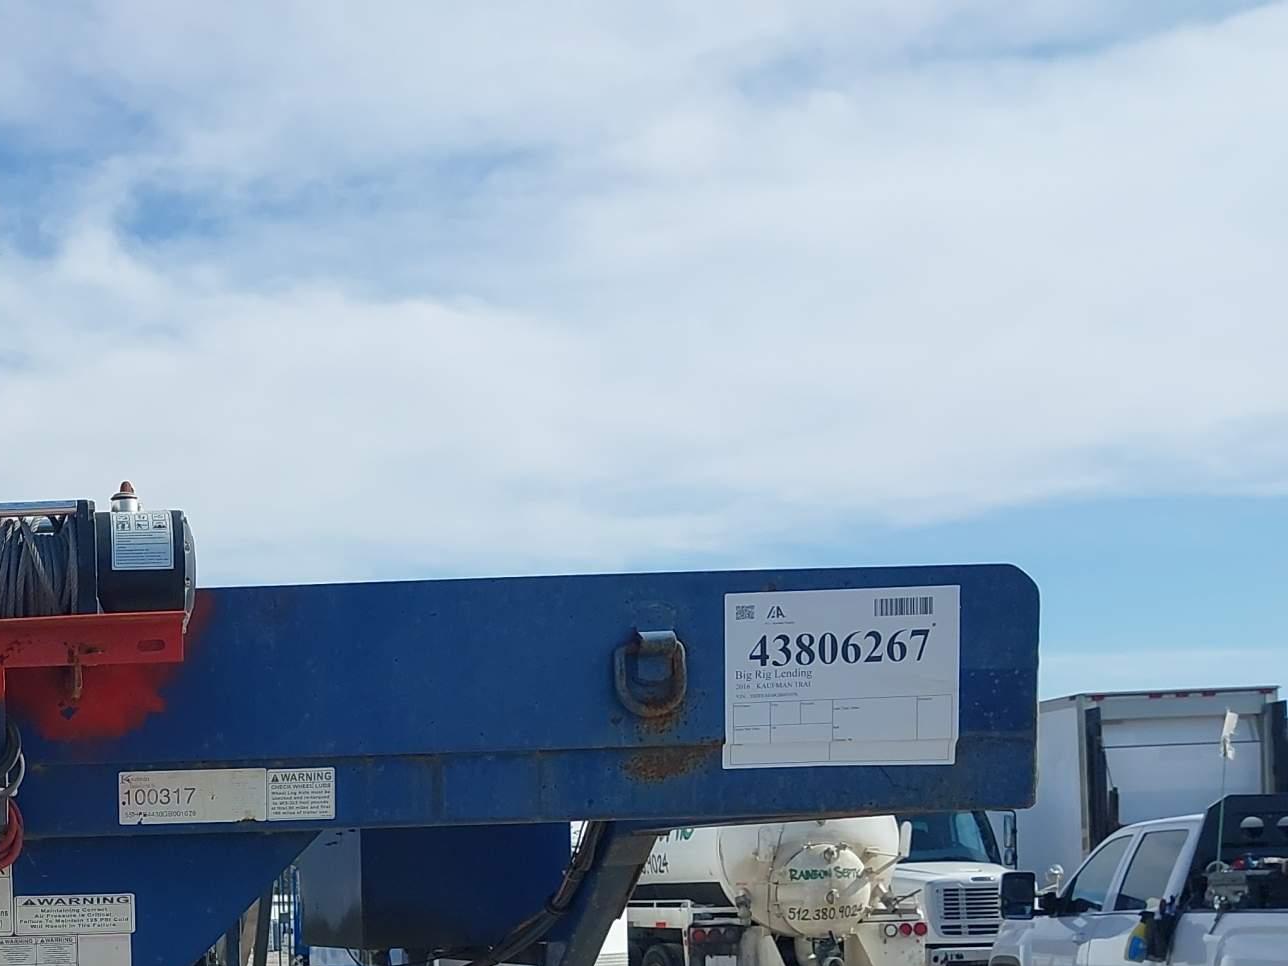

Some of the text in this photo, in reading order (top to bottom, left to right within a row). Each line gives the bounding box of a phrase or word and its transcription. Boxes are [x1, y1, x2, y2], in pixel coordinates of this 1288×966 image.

[749, 629, 930, 666] 43806267
[735, 668, 813, 681] Big Rig Lending
[281, 772, 332, 782] WARNING
[124, 787, 196, 805] 100317
[37, 896, 129, 905] WARNING
